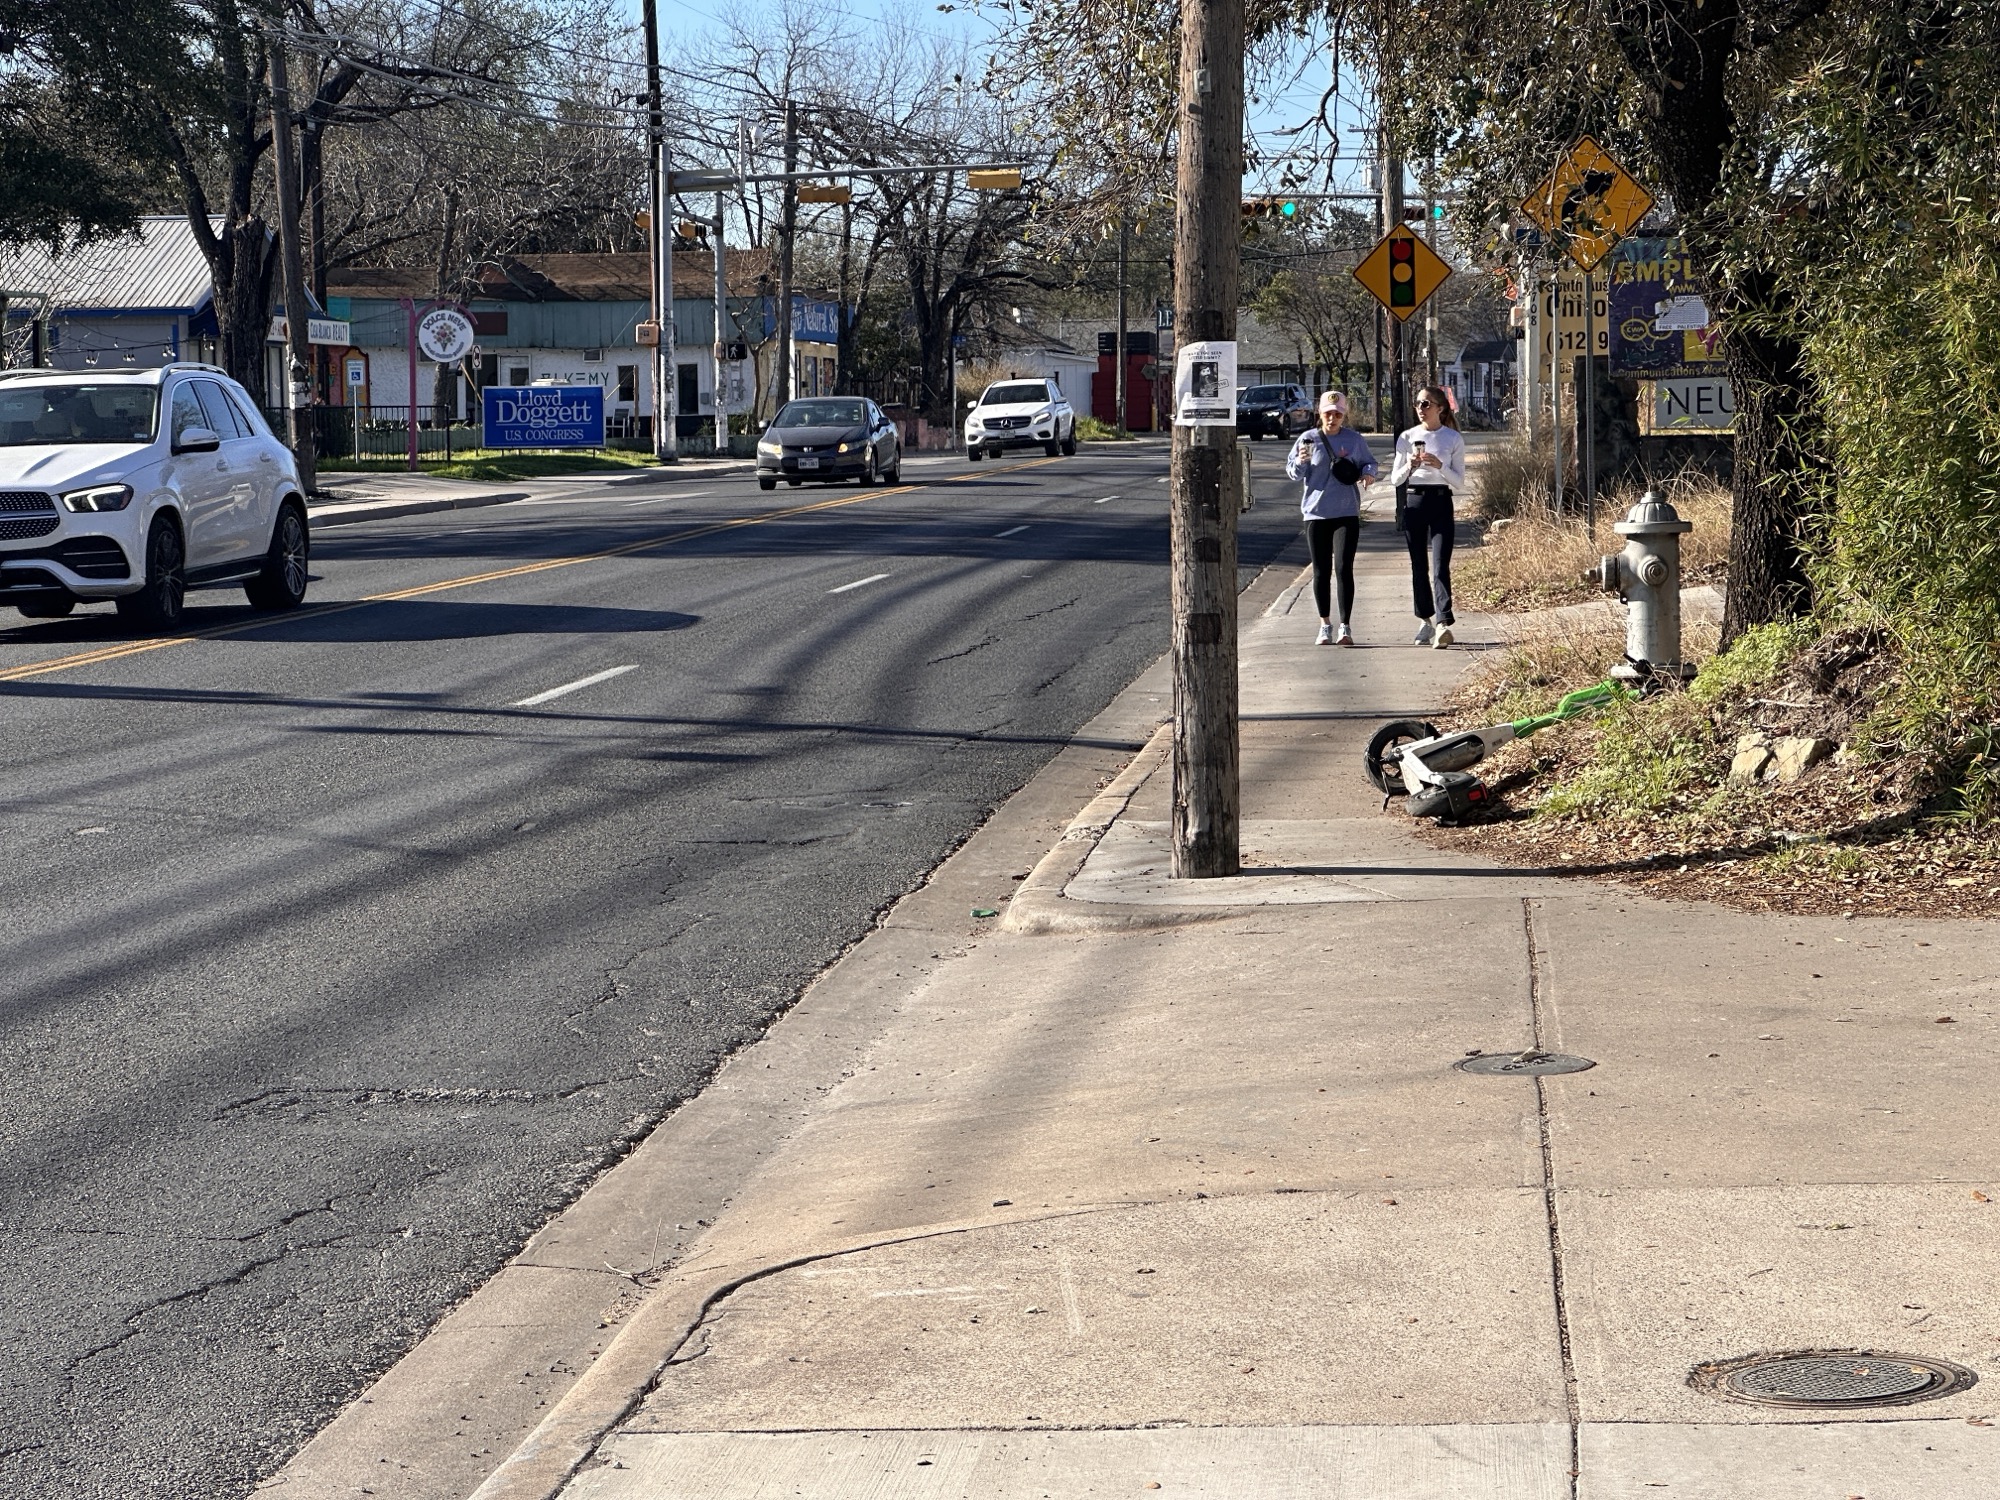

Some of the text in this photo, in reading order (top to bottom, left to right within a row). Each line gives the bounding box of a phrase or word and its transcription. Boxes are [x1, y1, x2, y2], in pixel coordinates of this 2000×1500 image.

[1547, 278, 1582, 292] Suth
[422, 312, 467, 331] DOLCE NEVE
[517, 389, 563, 408] Lloyd
[495, 400, 592, 429] Doggett
[504, 429, 584, 441] U.S. CONGRESS
